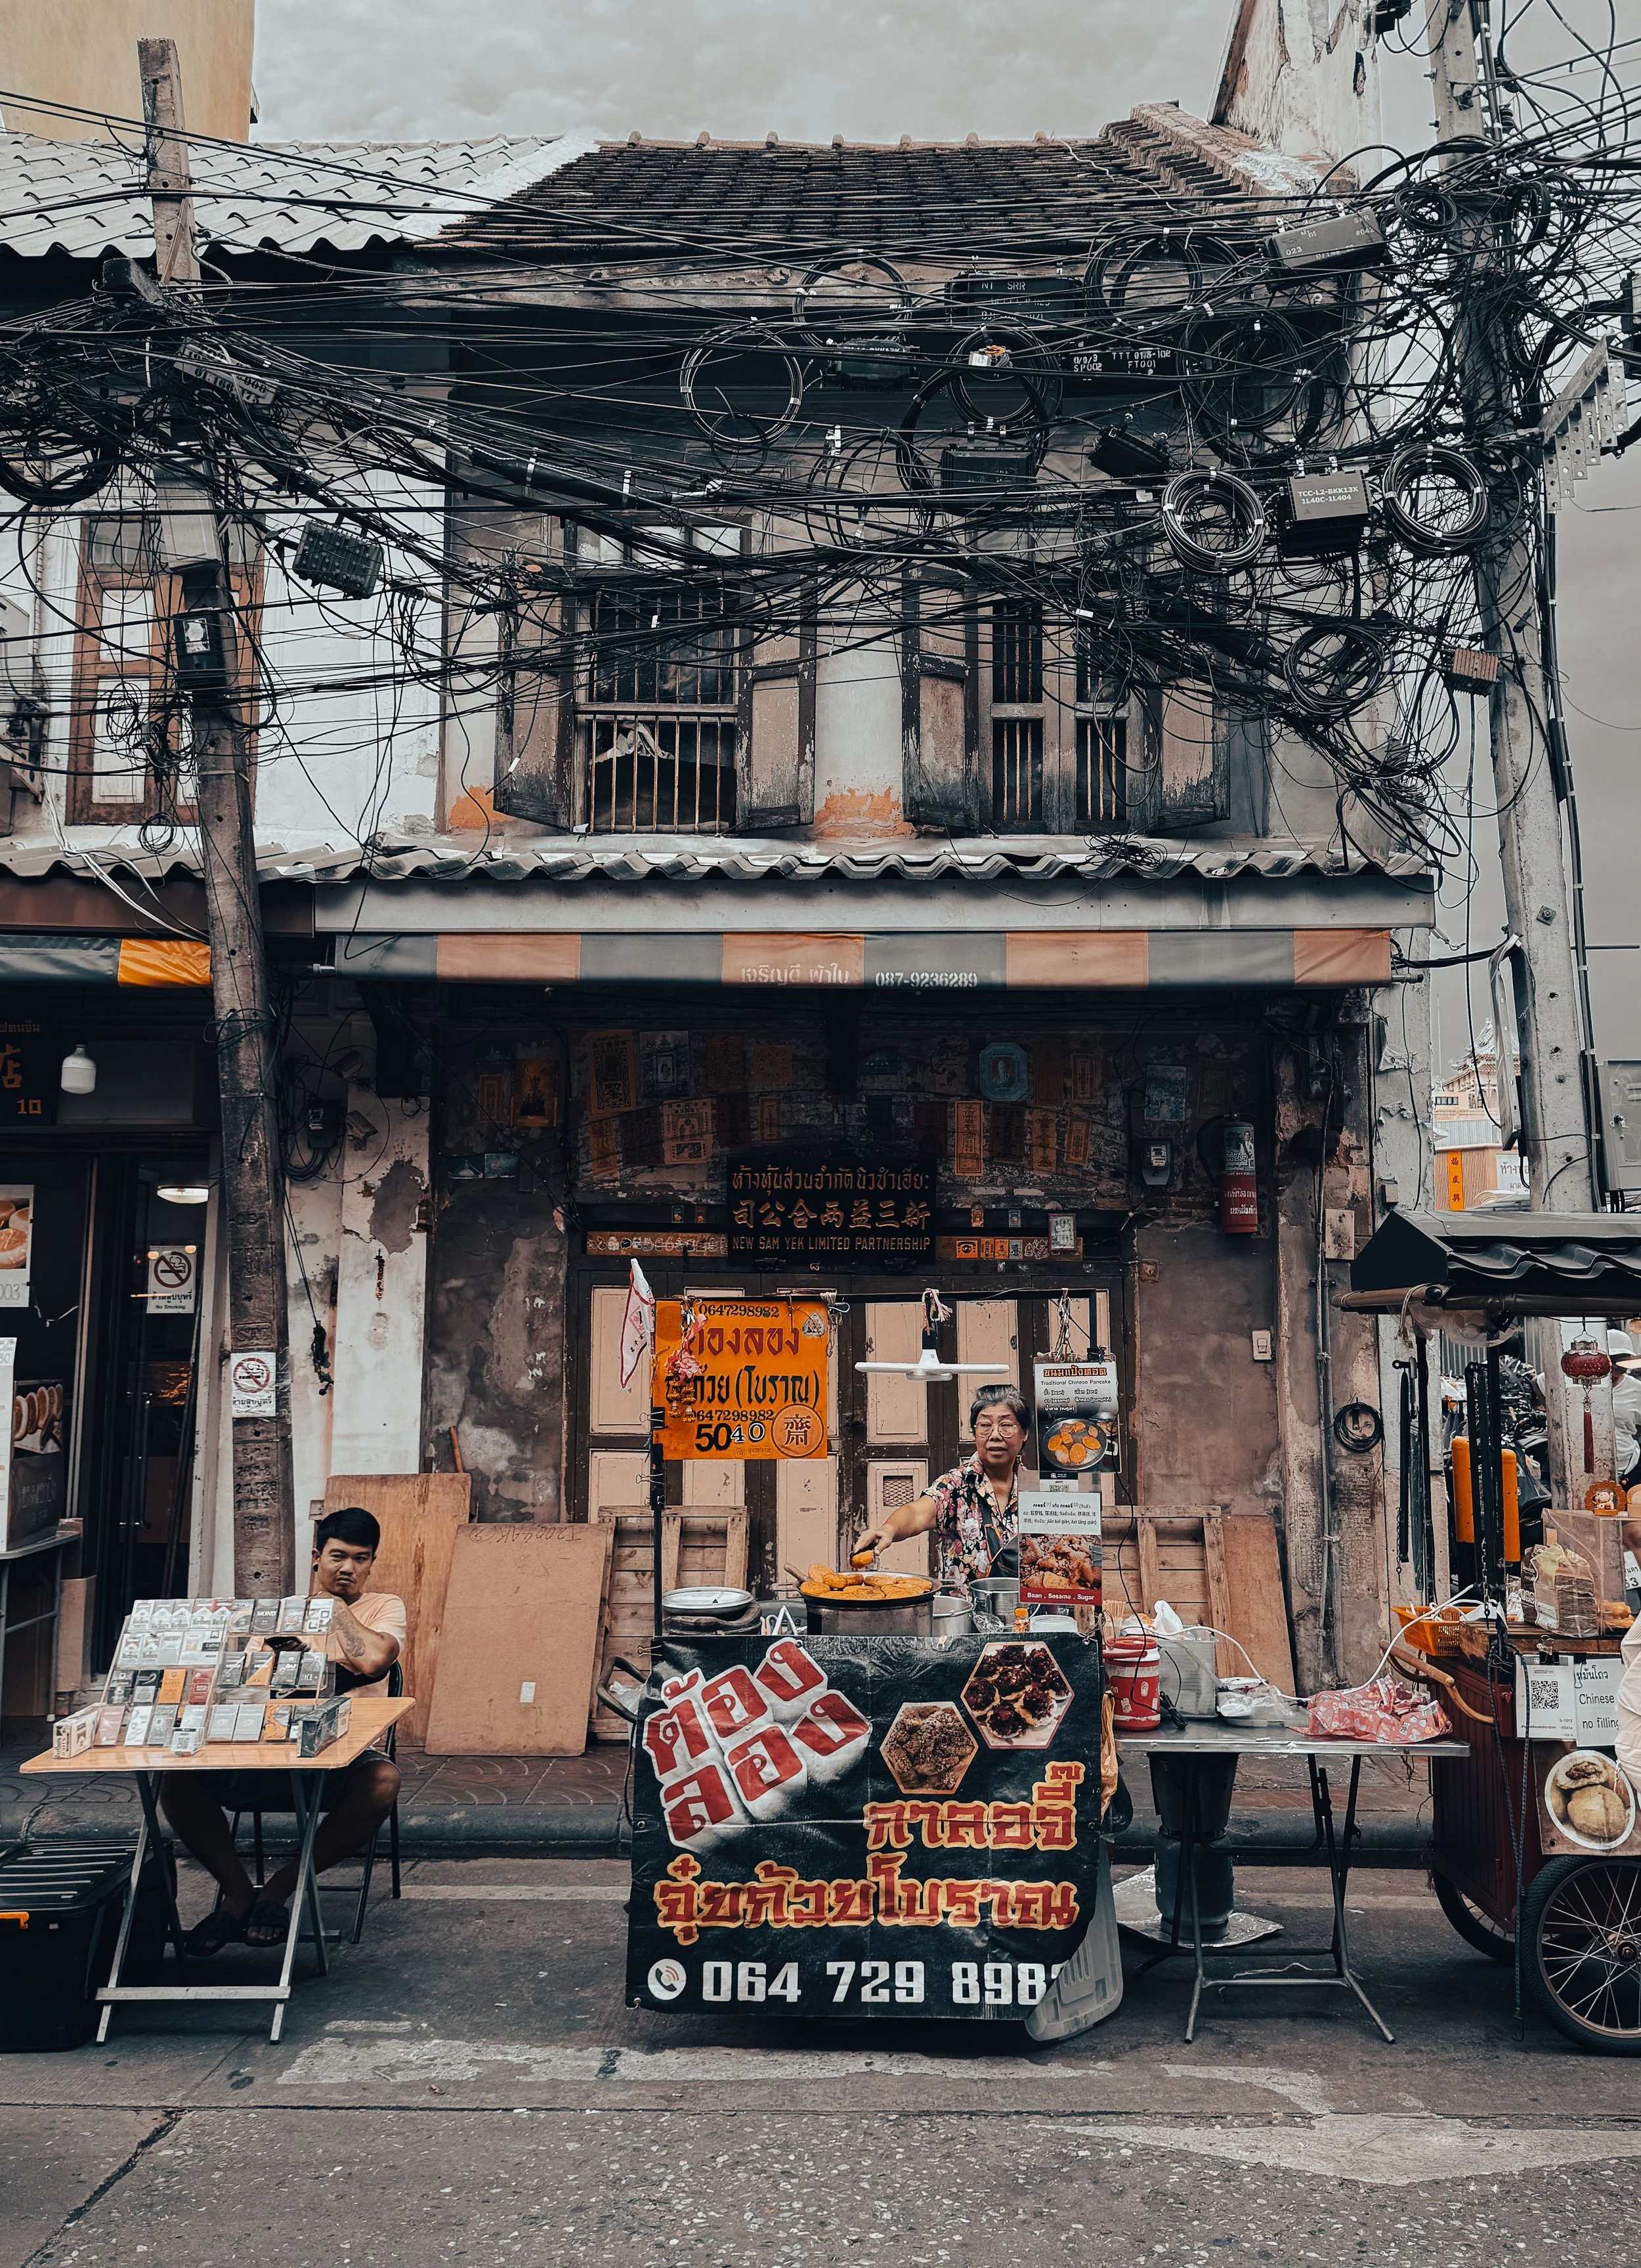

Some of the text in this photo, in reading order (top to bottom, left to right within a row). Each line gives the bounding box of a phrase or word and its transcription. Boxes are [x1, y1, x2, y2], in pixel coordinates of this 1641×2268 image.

[1285, 246, 1303, 256] 023
[1007, 281, 1025, 291] SRR
[875, 972, 978, 988] 087-9236289
[16, 1099, 41, 1114] 10
[733, 1237, 930, 1251] NEW SAM YEK LIMITED PARTNERSHIP
[698, 1304, 780, 1317] 0647298982
[1044, 1365, 1107, 1377] ขนมแป้งทอด
[736, 1365, 820, 1408] (โบราณ)
[1579, 1694, 1615, 1705] Chinese
[1583, 1719, 1593, 1729] no
[702, 1961, 1067, 2006] 064 729 898
